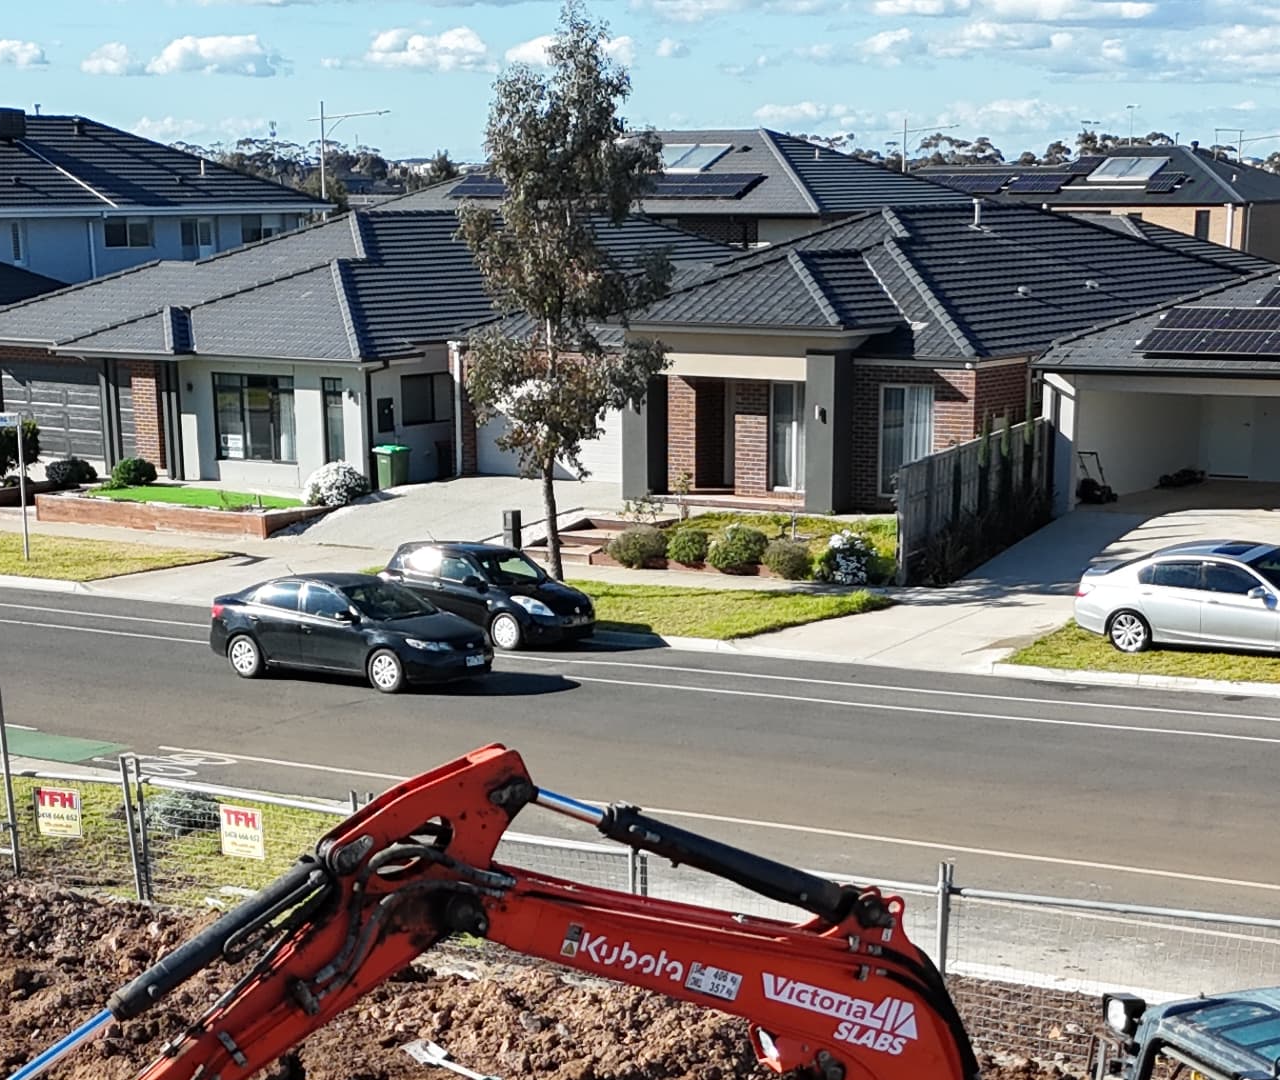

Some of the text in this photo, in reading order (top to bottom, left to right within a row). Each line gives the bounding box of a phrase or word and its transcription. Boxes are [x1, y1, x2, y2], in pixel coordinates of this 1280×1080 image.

[37, 790, 75, 808] TFH
[223, 808, 258, 829] TFH
[580, 932, 683, 981] Kubota
[772, 974, 868, 1020] Victoria
[833, 1021, 907, 1055] SLABS
